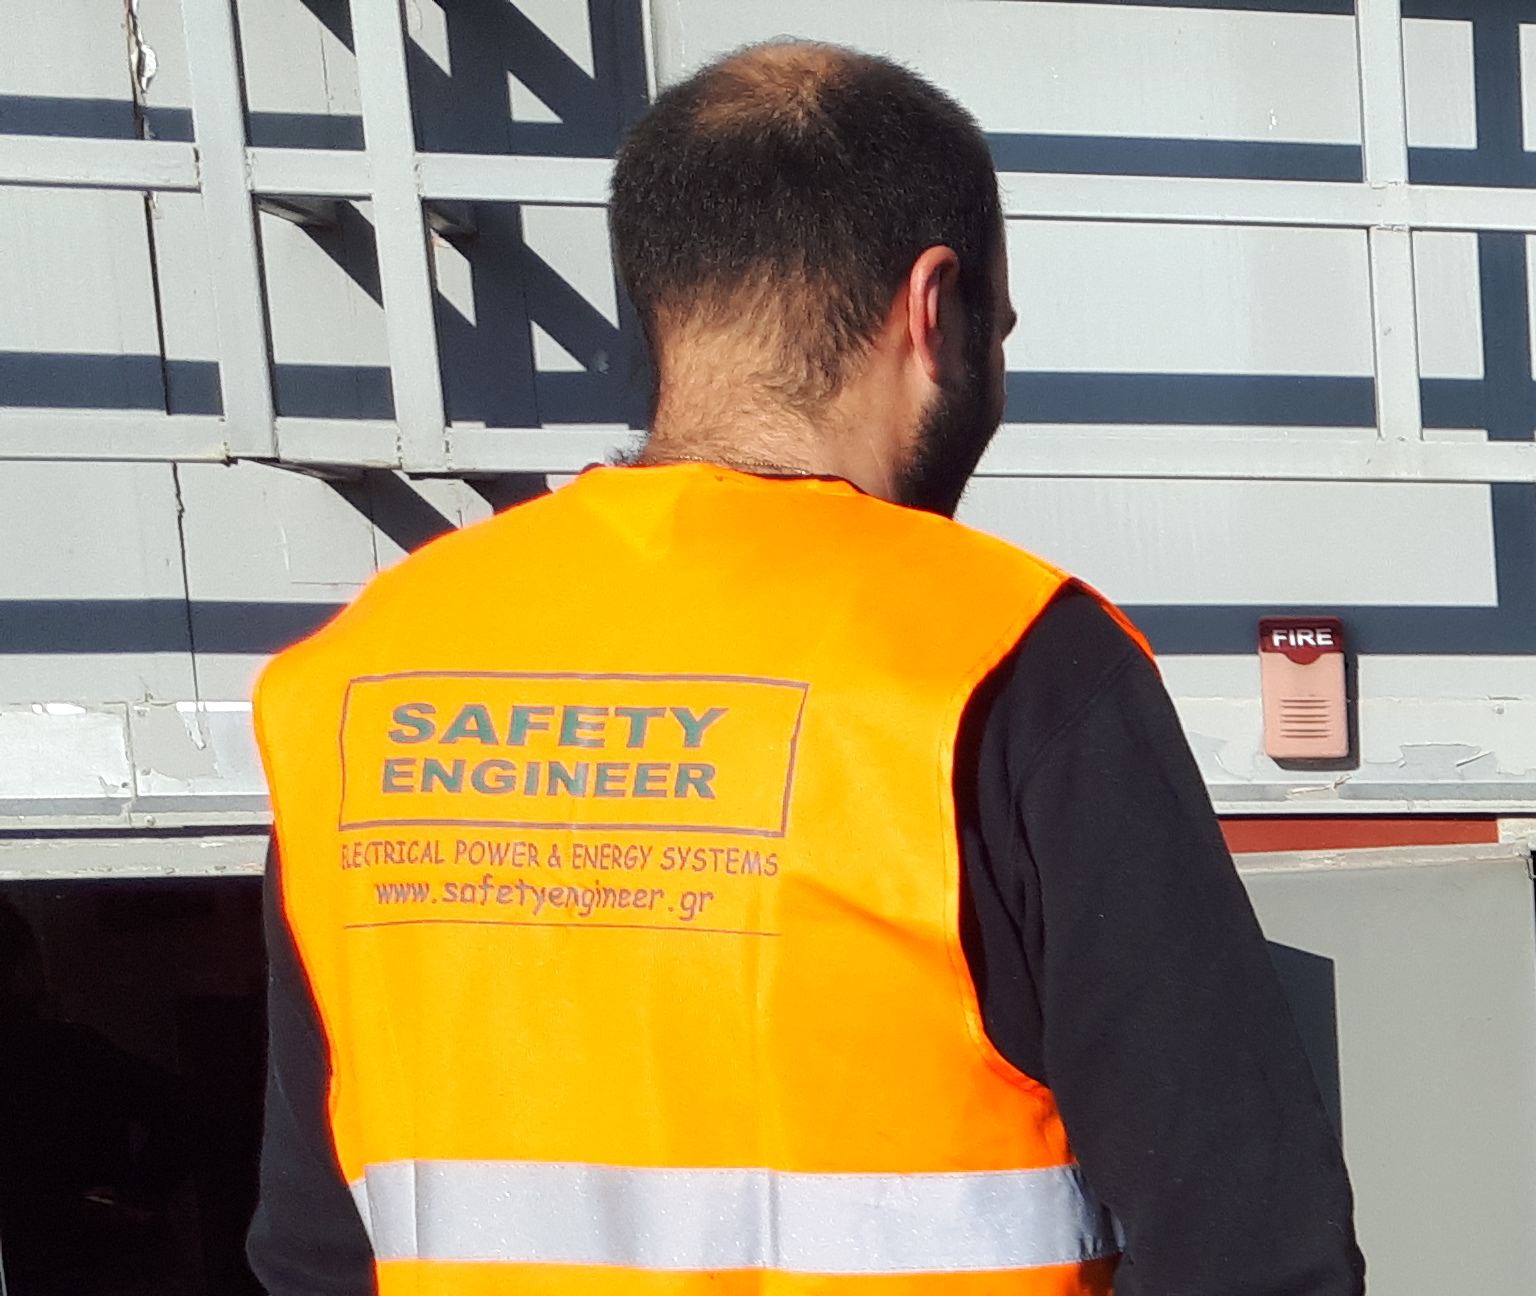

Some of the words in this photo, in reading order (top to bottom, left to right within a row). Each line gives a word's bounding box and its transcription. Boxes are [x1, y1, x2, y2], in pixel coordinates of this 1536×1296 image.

[1271, 627, 1334, 647] FIRE
[386, 701, 730, 749] SAFETY
[381, 756, 718, 800] ENGINEER
[454, 839, 540, 868] POWER
[547, 843, 562, 869] &
[571, 843, 653, 871] ENERGY
[659, 846, 780, 877] SYSTEMS
[374, 873, 715, 921] www.safetyengineer.gr
